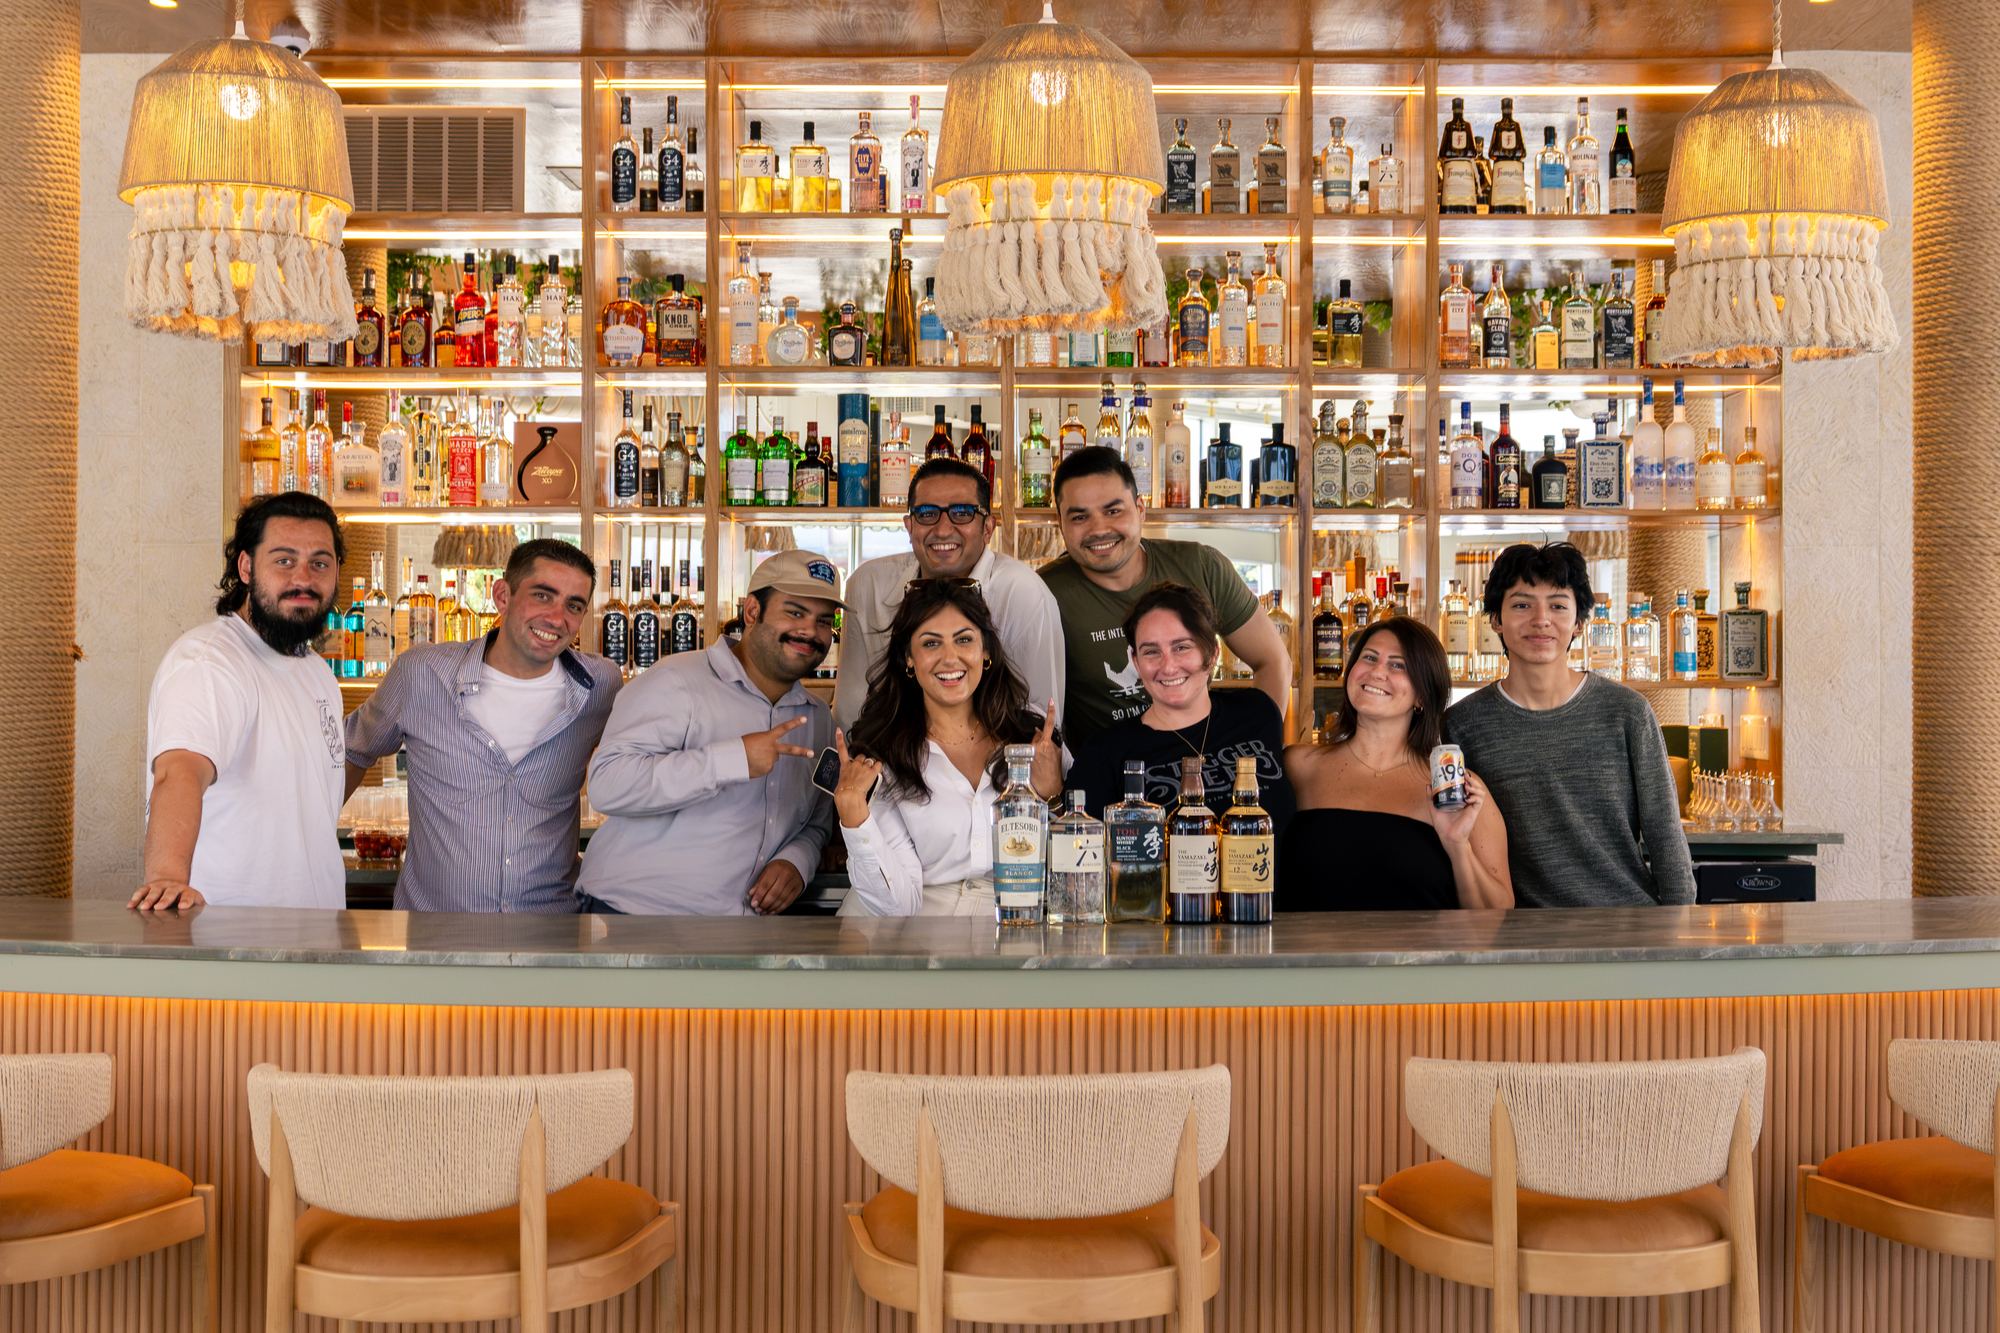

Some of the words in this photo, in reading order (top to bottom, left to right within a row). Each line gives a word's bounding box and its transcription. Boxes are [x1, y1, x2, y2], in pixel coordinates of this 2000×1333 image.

[615, 154, 631, 167] G4
[662, 154, 678, 167] G4
[458, 309, 484, 321] APEROL
[664, 314, 688, 324] KNOB
[618, 450, 635, 461] G4
[1462, 458, 1477, 474] Q
[541, 477, 553, 485] XO
[607, 619, 624, 632] G4
[638, 619, 655, 632] G4
[675, 619, 692, 632] G4
[1090, 630, 1107, 642] THE
[1111, 708, 1124, 720] SO
[1126, 705, 1140, 718] I'M
[1001, 824, 1009, 833] EL
[1010, 822, 1038, 833] TESORO
[1142, 825, 1164, 859] 季
[1233, 866, 1241, 874] 12
[1742, 877, 1774, 887] KROWNE
